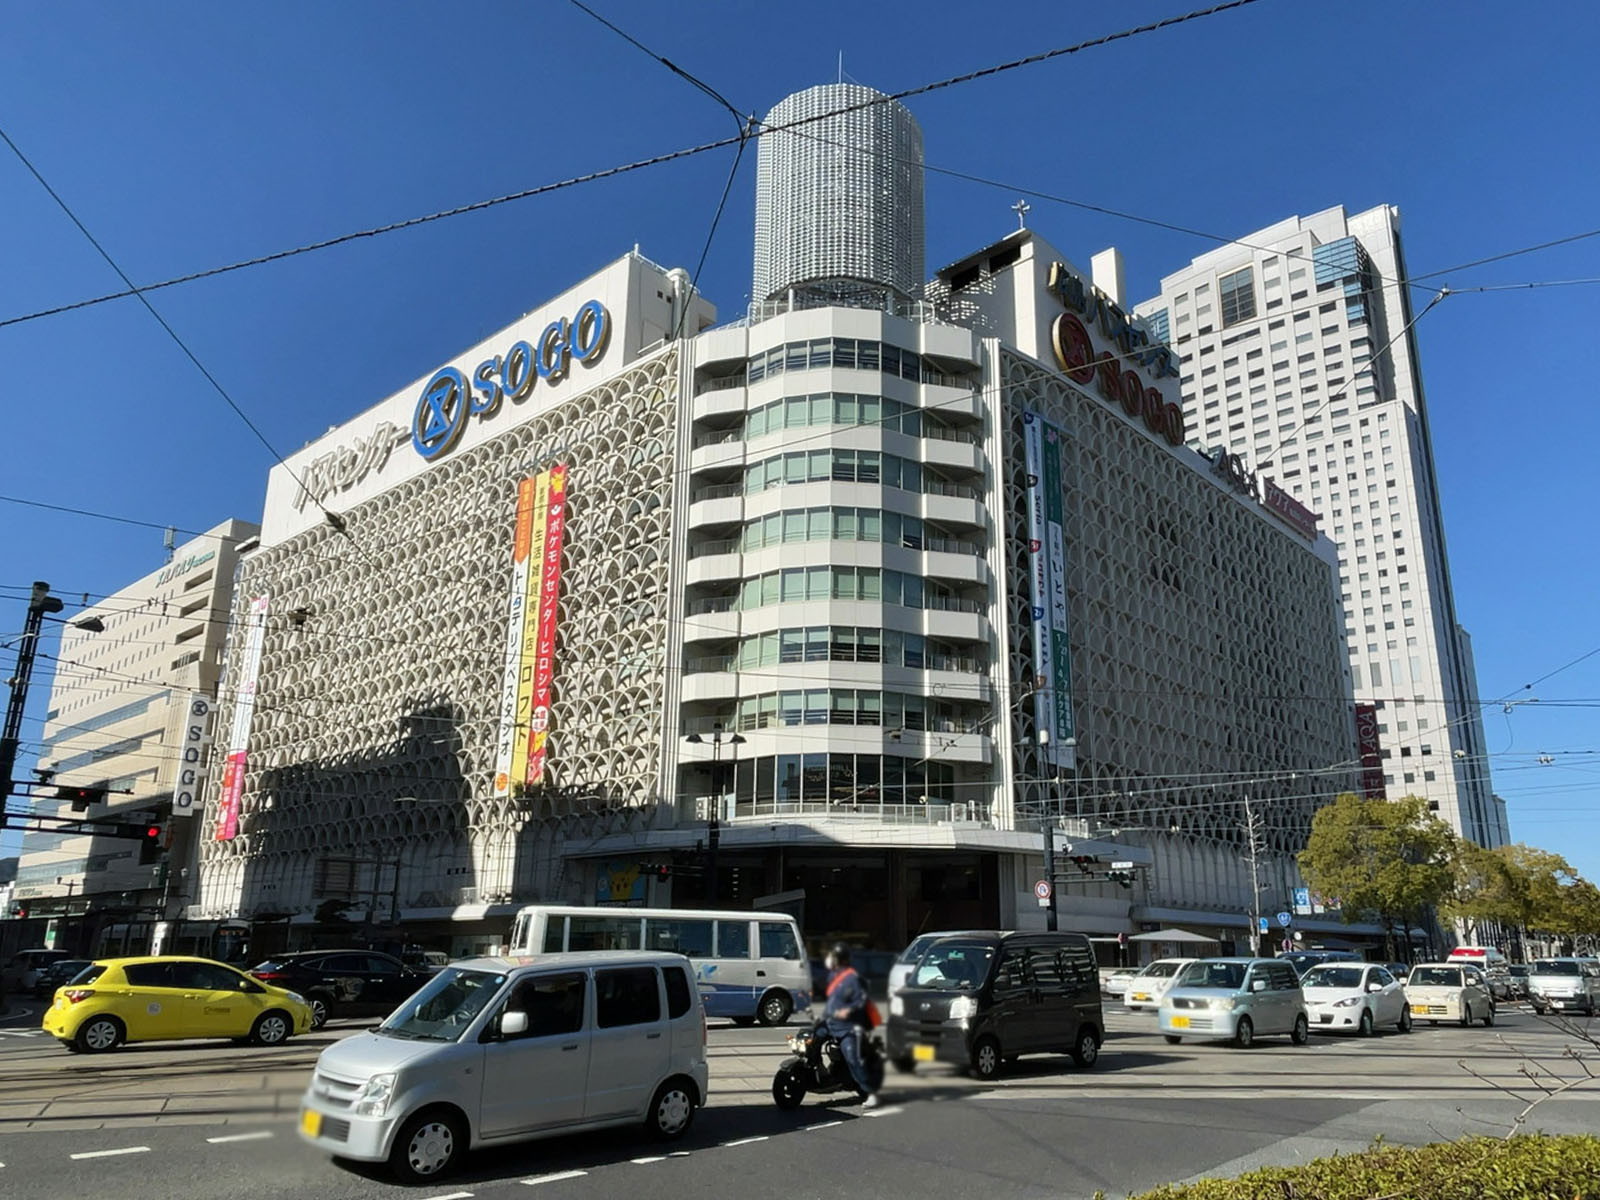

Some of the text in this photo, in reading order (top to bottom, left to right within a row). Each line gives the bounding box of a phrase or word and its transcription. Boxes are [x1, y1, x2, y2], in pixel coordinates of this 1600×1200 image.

[471, 299, 609, 416] SOGO
[1096, 350, 1185, 446] SOGO
[292, 421, 411, 512] バスセンター
[1034, 495, 1042, 525] Seria
[535, 517, 561, 701] ポケモンセンターヒロシマ
[516, 664, 533, 747] ロフト
[178, 725, 202, 808] SOGO
